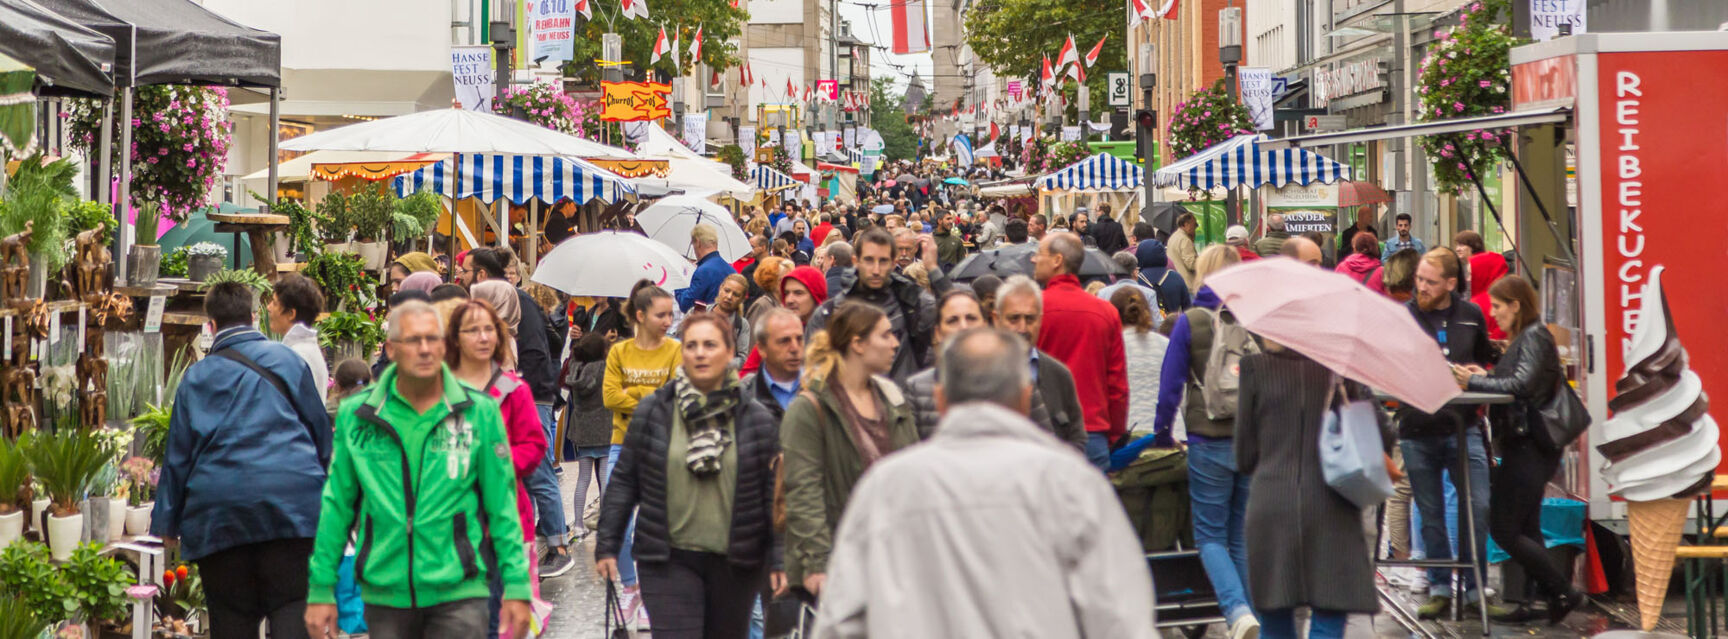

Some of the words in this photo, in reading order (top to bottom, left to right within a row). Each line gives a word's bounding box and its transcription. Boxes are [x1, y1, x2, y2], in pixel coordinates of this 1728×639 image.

[1533, 0, 1568, 12] FEST
[1533, 15, 1581, 28] NEUSS
[549, 31, 570, 40] NEUSS
[452, 53, 488, 63] HANSE
[453, 63, 478, 74] FEST
[455, 74, 489, 85] NEUSS
[1240, 72, 1269, 80] HANSE
[1112, 77, 1126, 102] Tee
[1241, 80, 1261, 89] FEST
[1242, 90, 1270, 98] NEUSS
[606, 92, 634, 107] Churros
[1286, 213, 1304, 222] AUS
[1306, 213, 1325, 222] DER
